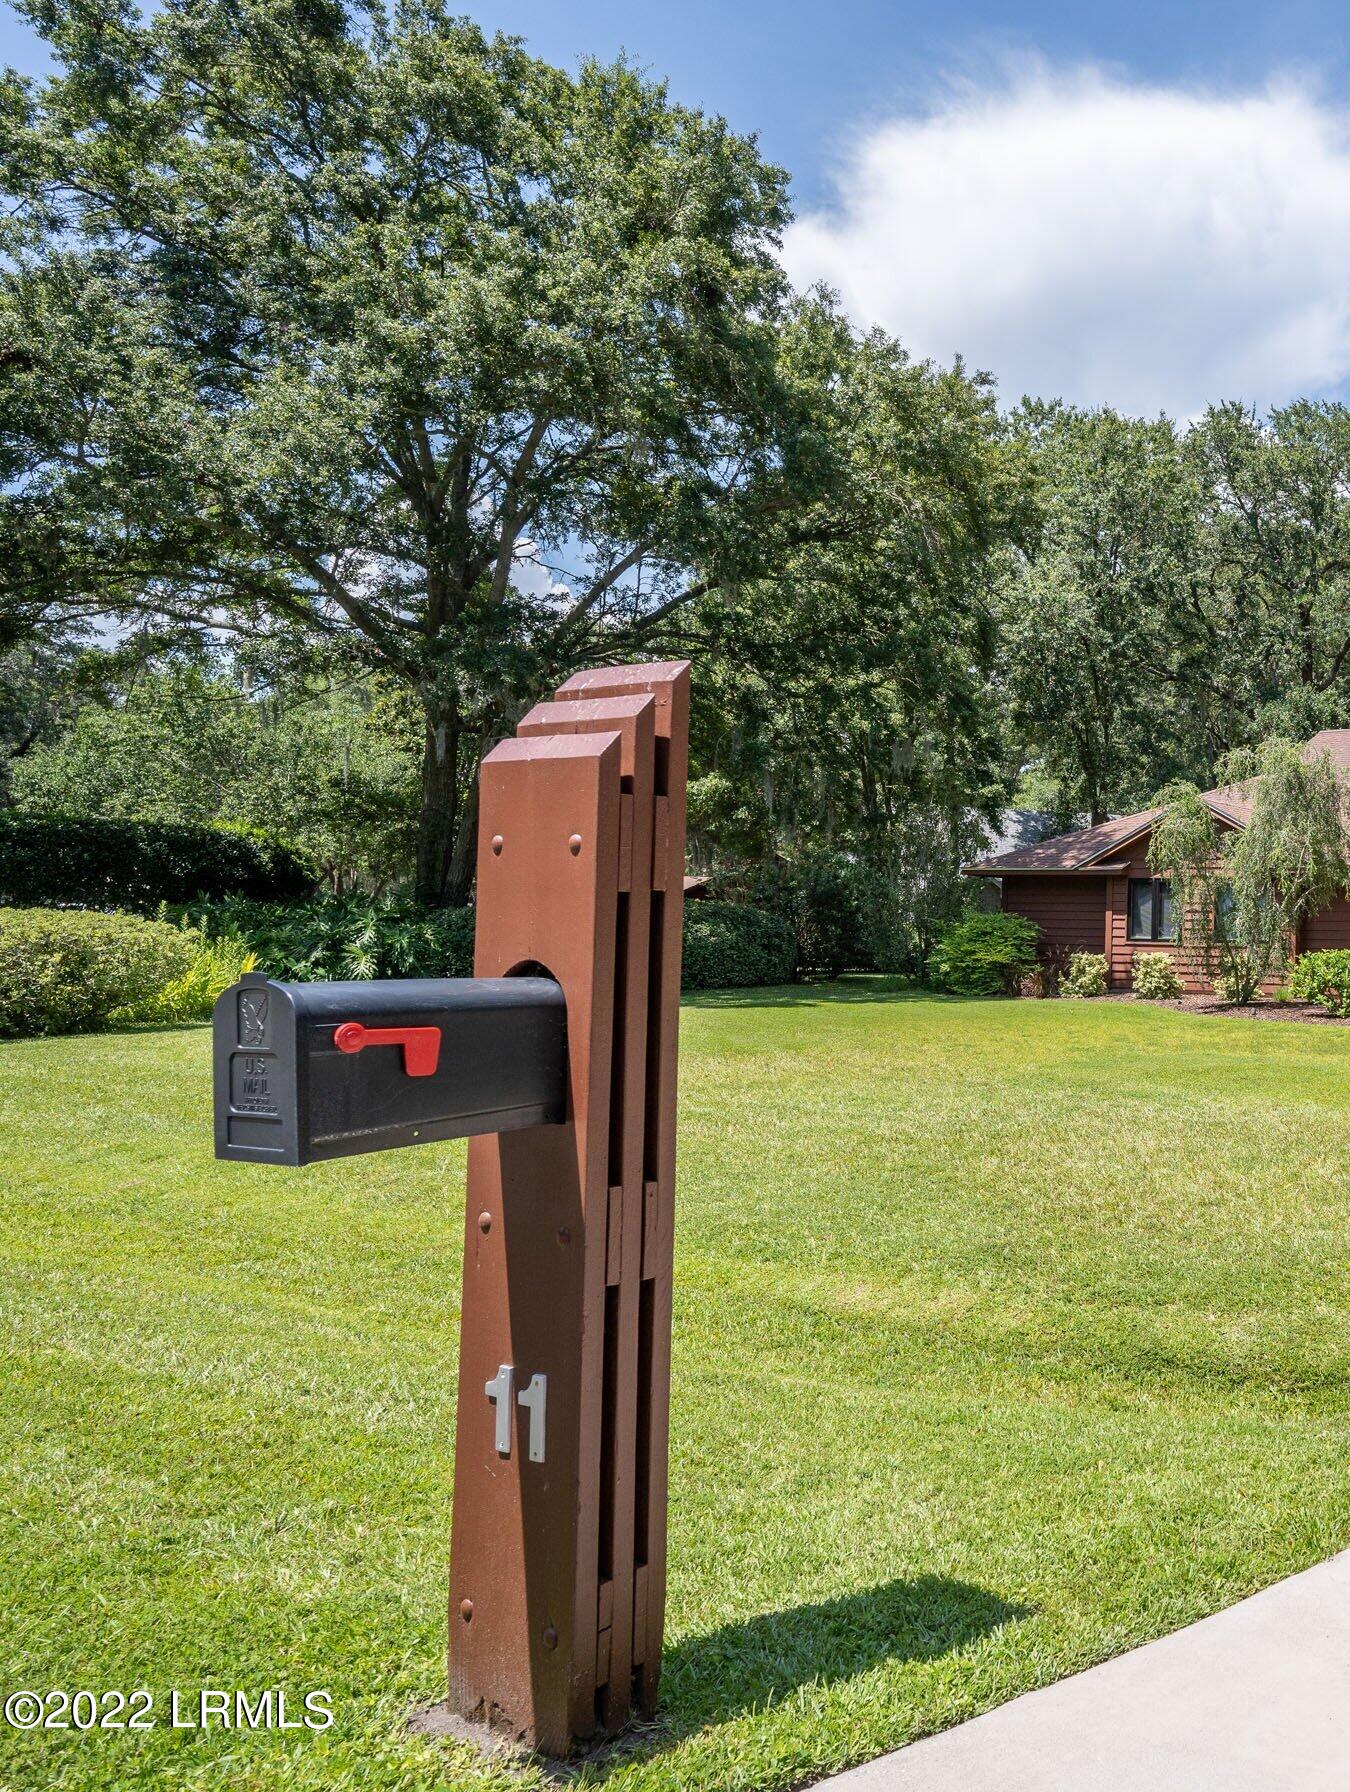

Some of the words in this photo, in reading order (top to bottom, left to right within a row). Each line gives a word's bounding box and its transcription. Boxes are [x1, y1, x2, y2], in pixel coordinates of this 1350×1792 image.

[245, 1056, 268, 1075] U.S.
[243, 1076, 271, 1096] MAIL
[484, 1364, 547, 1463] 11
